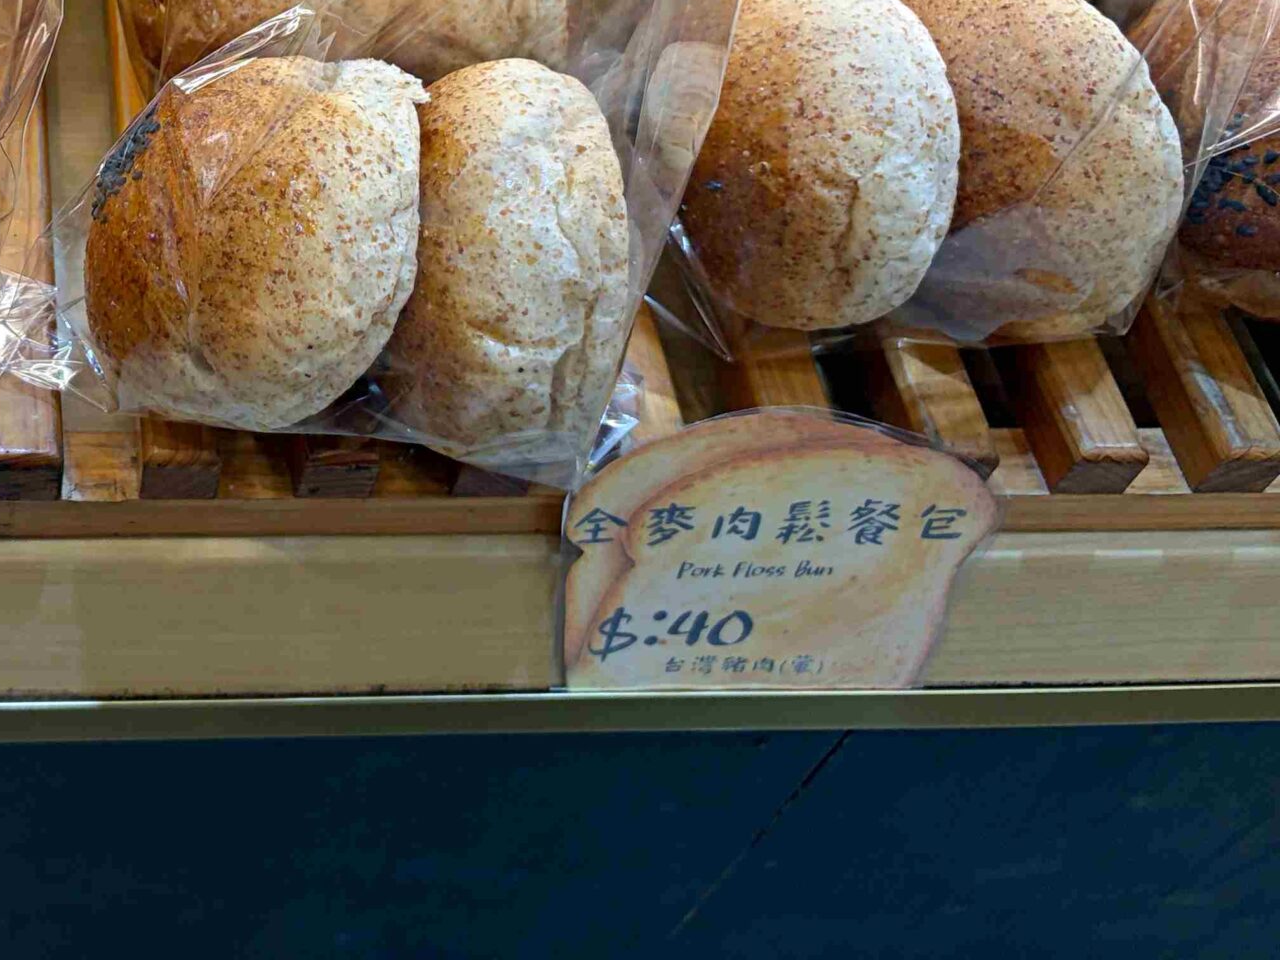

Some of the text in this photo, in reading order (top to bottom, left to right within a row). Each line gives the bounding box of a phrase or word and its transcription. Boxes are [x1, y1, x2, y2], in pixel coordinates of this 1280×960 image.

[573, 498, 968, 546] 全麥肉鬆餐包
[677, 560, 833, 579] Pork Floss Bun
